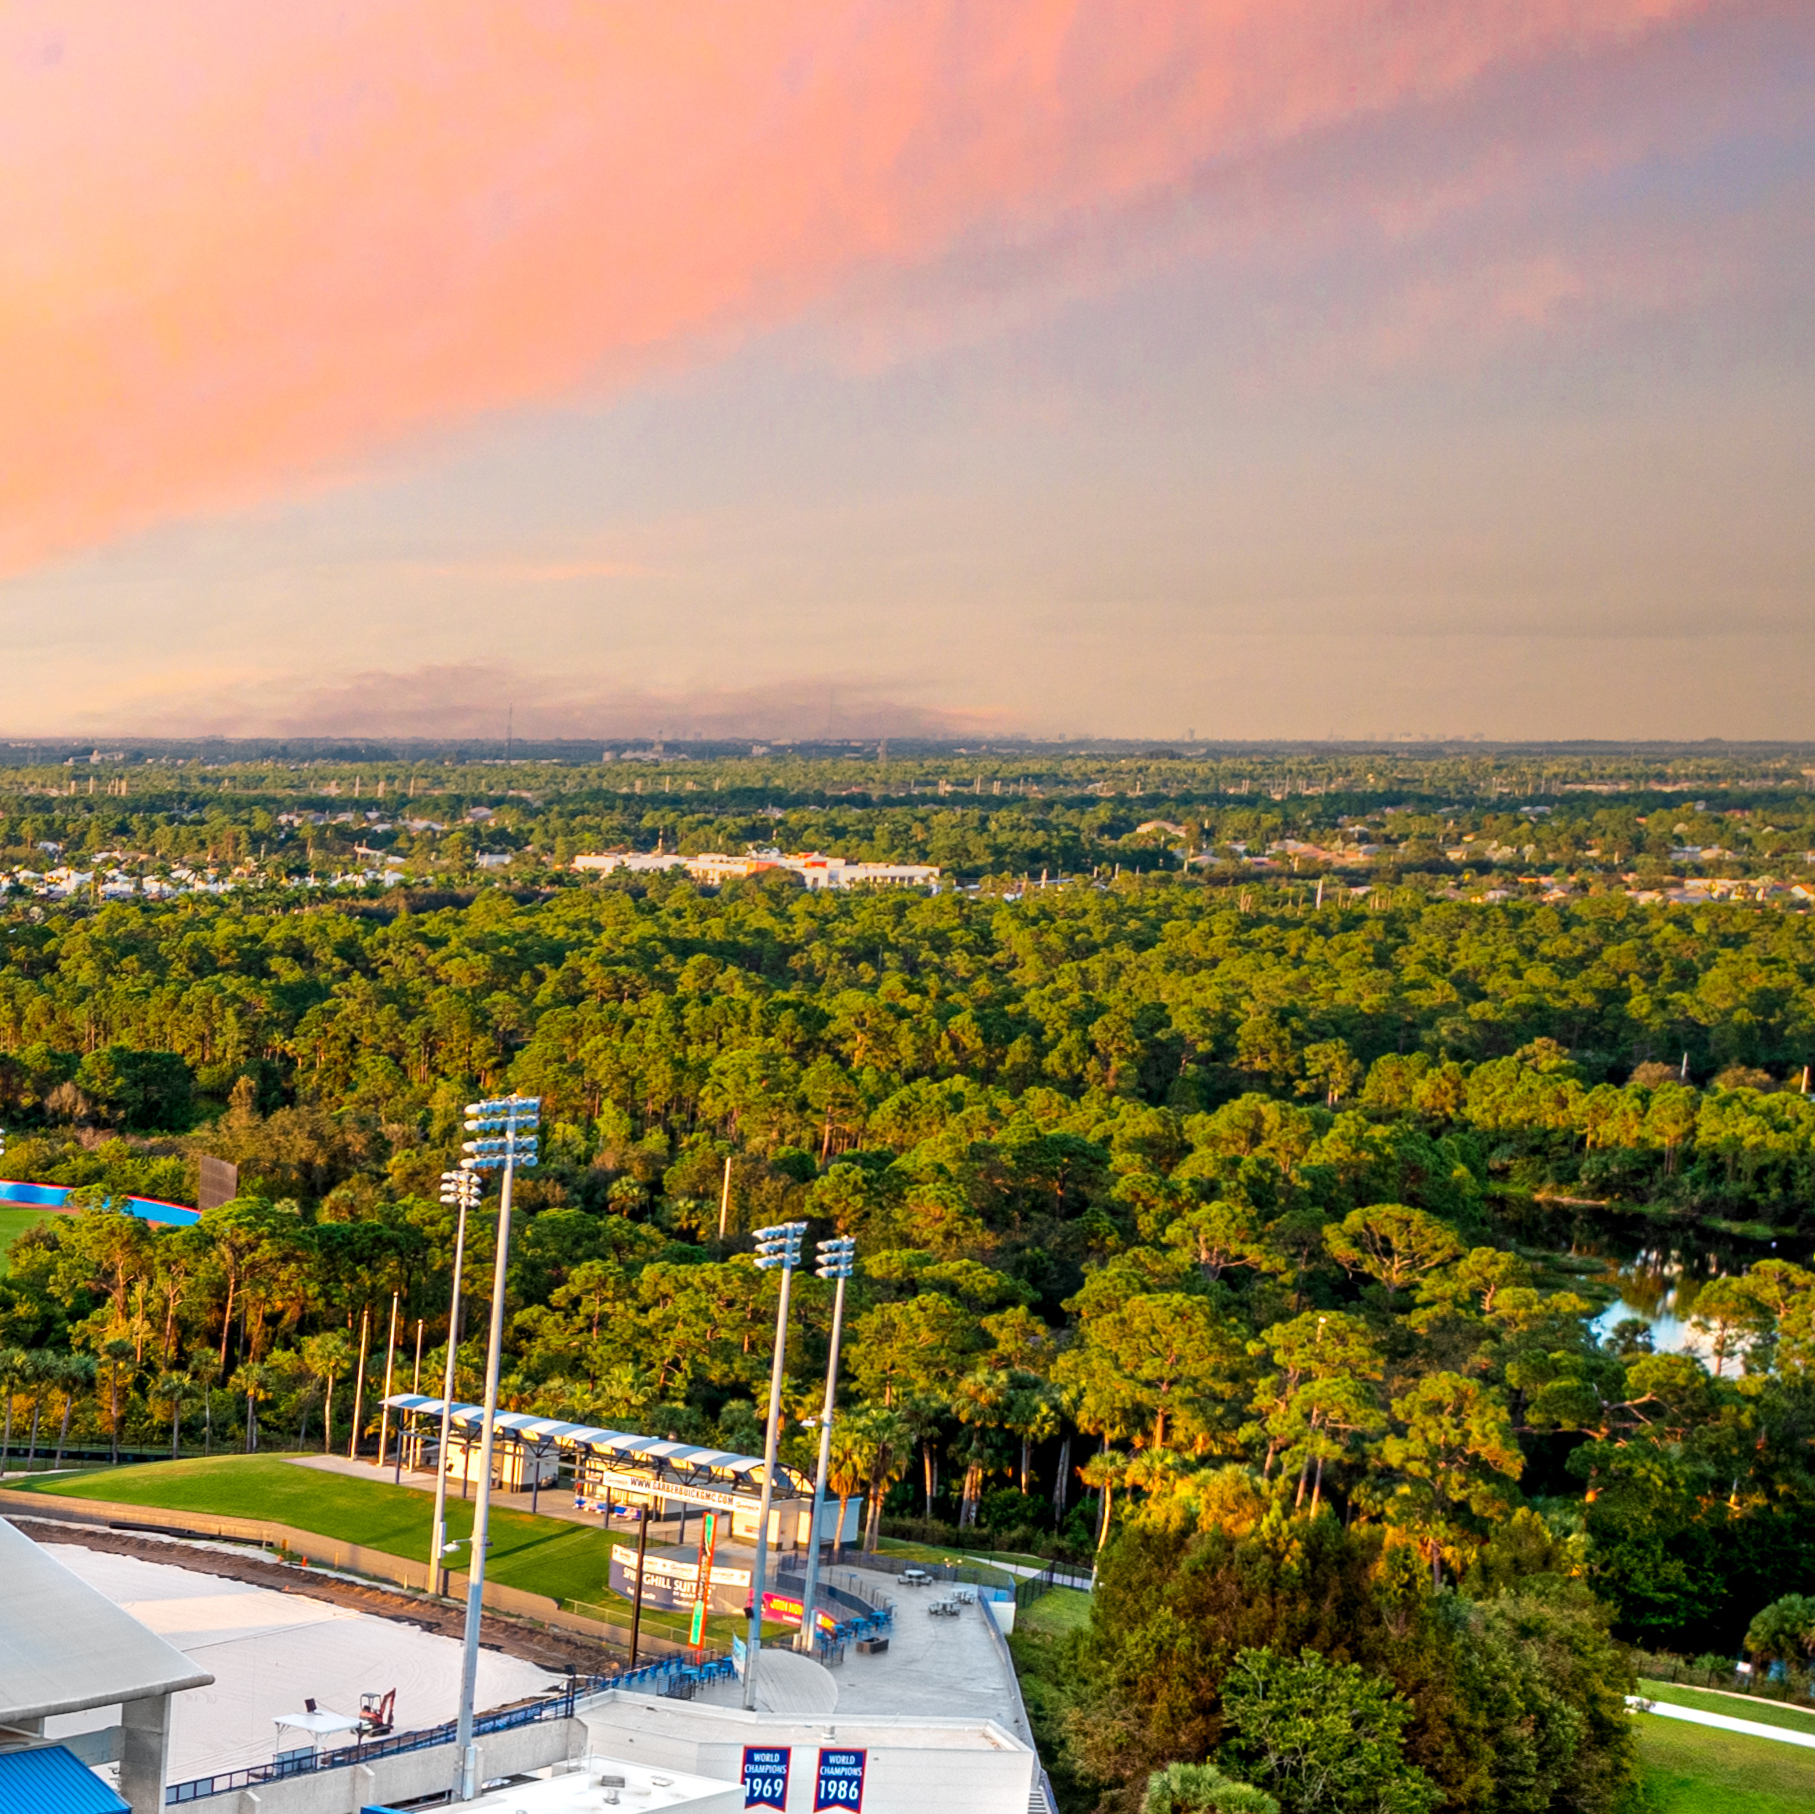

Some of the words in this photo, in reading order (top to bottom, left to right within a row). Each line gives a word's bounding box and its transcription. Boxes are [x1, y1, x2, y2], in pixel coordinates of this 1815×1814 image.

[753, 1752, 780, 1763] WORLD
[829, 1755, 856, 1765] WORLD
[744, 1764, 787, 1775] CHAMPIONS
[819, 1766, 863, 1777] CHAMPIONS
[744, 1778, 784, 1798] 1969
[819, 1780, 859, 1800] 1986
